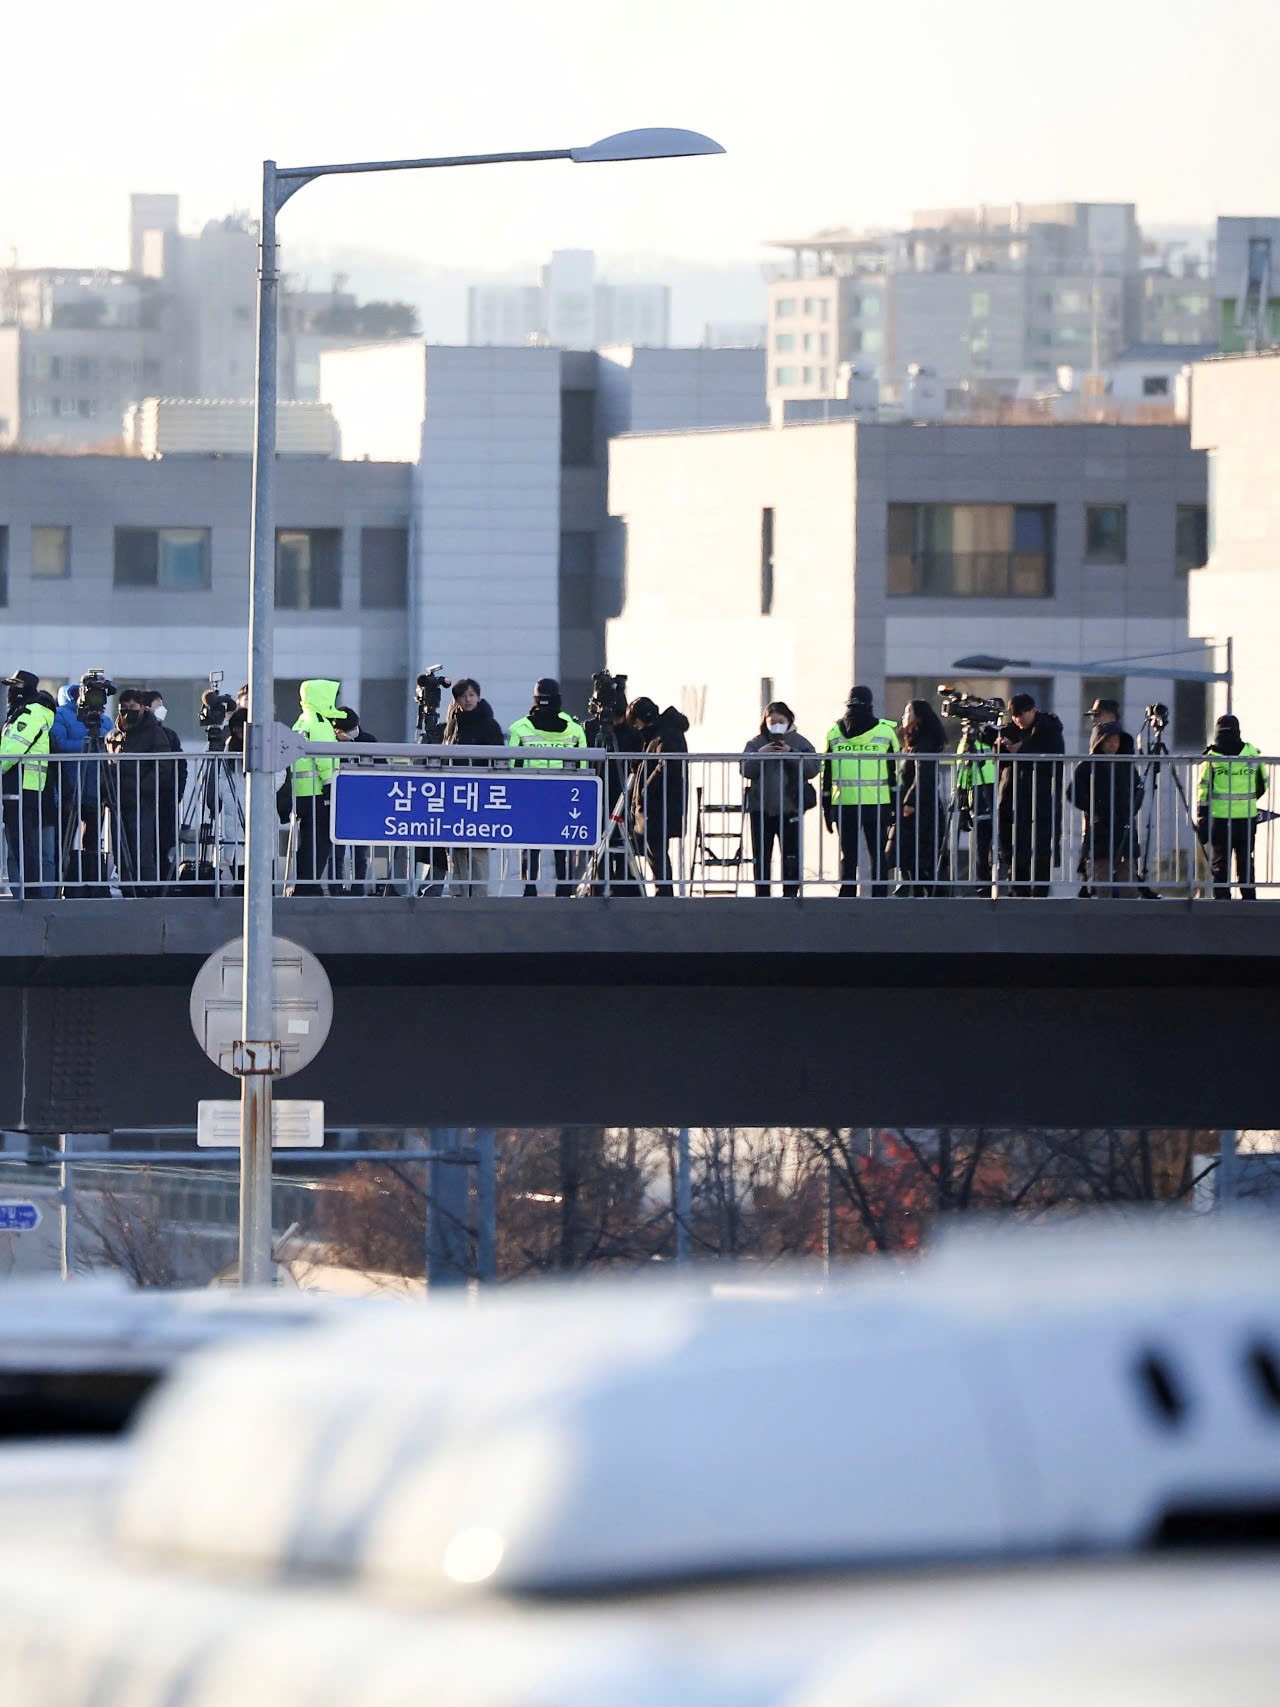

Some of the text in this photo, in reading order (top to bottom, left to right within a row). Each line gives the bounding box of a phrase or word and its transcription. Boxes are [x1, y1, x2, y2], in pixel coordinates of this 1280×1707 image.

[387, 781, 512, 813] 삼일대로
[571, 788, 580, 802] 2
[384, 816, 513, 838] Samil-daero
[561, 825, 588, 840] 476
